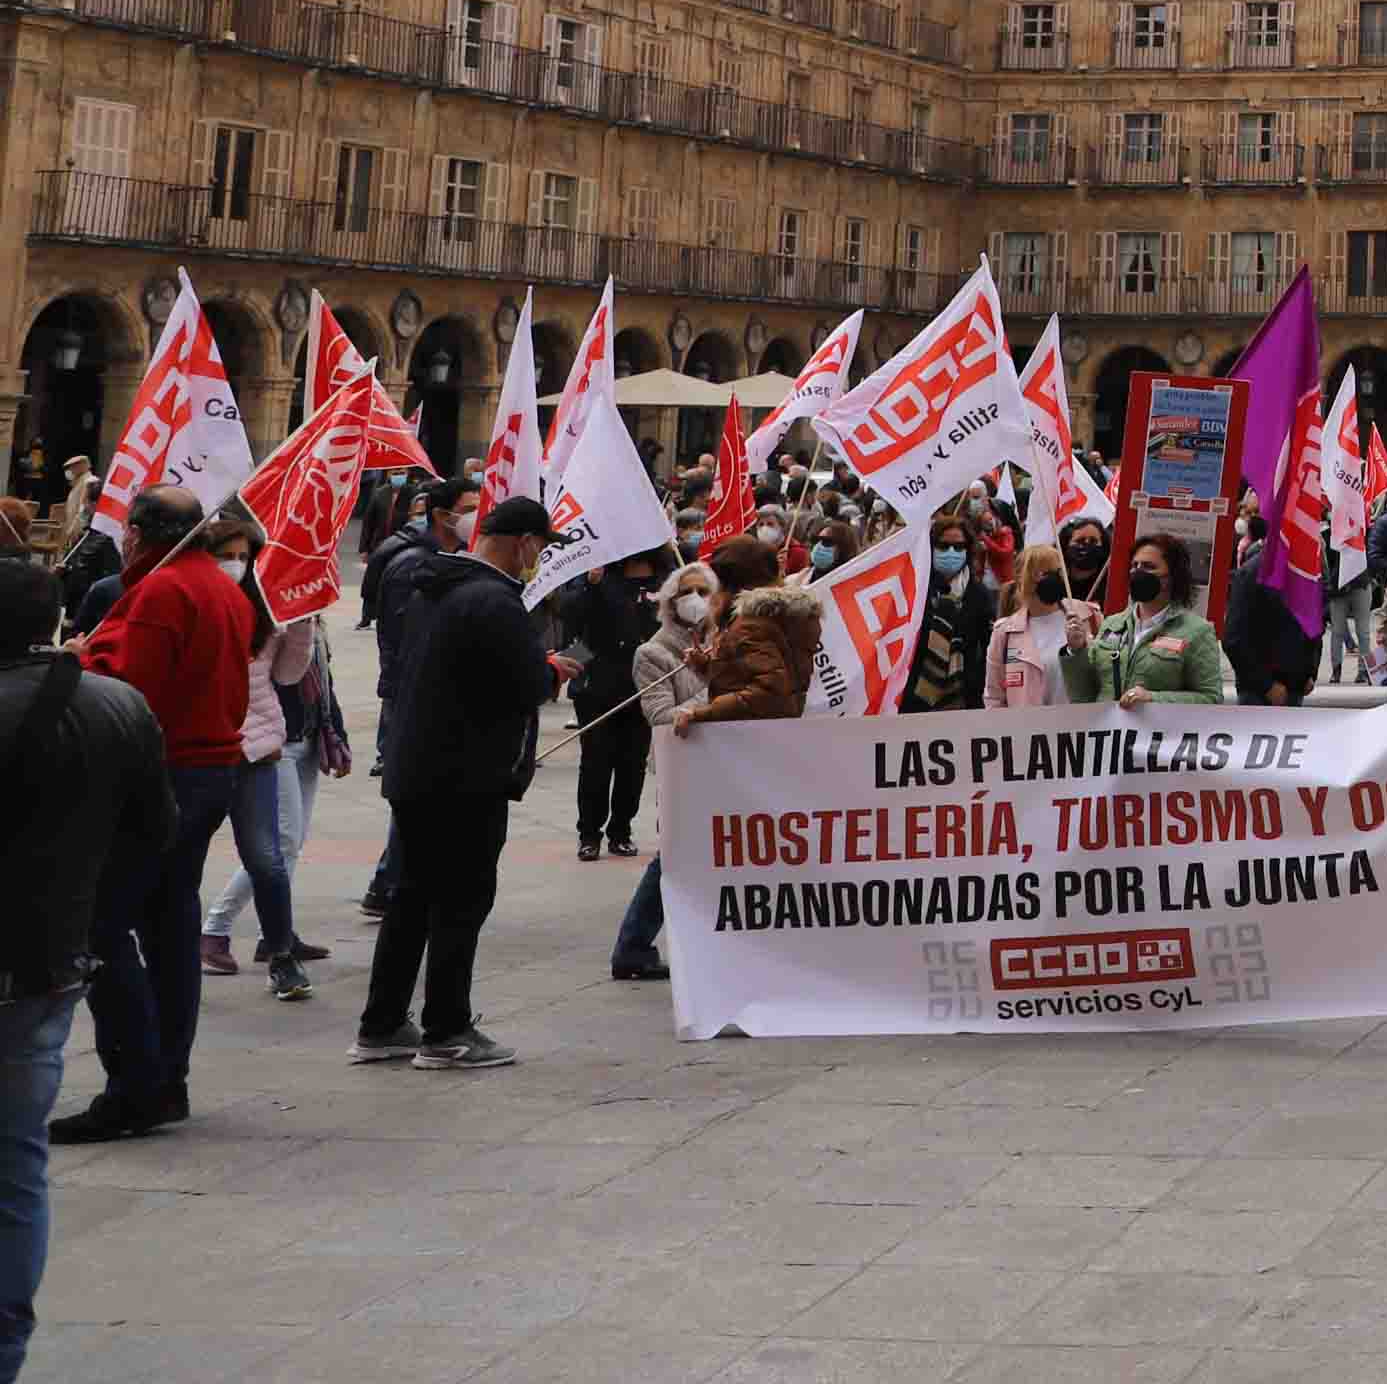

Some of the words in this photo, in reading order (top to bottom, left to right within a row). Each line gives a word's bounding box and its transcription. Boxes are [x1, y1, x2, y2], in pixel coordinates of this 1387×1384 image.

[874, 739, 956, 789] LAS
[970, 729, 1233, 784] PLANTILLAS
[1244, 733, 1309, 770] DE
[712, 790, 1033, 867] HOSTELERÍA,
[1052, 787, 1284, 853] TURISMO
[1297, 785, 1330, 837] Y
[714, 872, 1041, 933] ABANDONADAS
[1054, 865, 1146, 918] POR
[1158, 862, 1212, 913] LA
[1224, 849, 1380, 908] JUNTA
[1000, 942, 1129, 980] CCOO
[997, 989, 1143, 1021] servicios
[1150, 986, 1203, 1013] CyL
